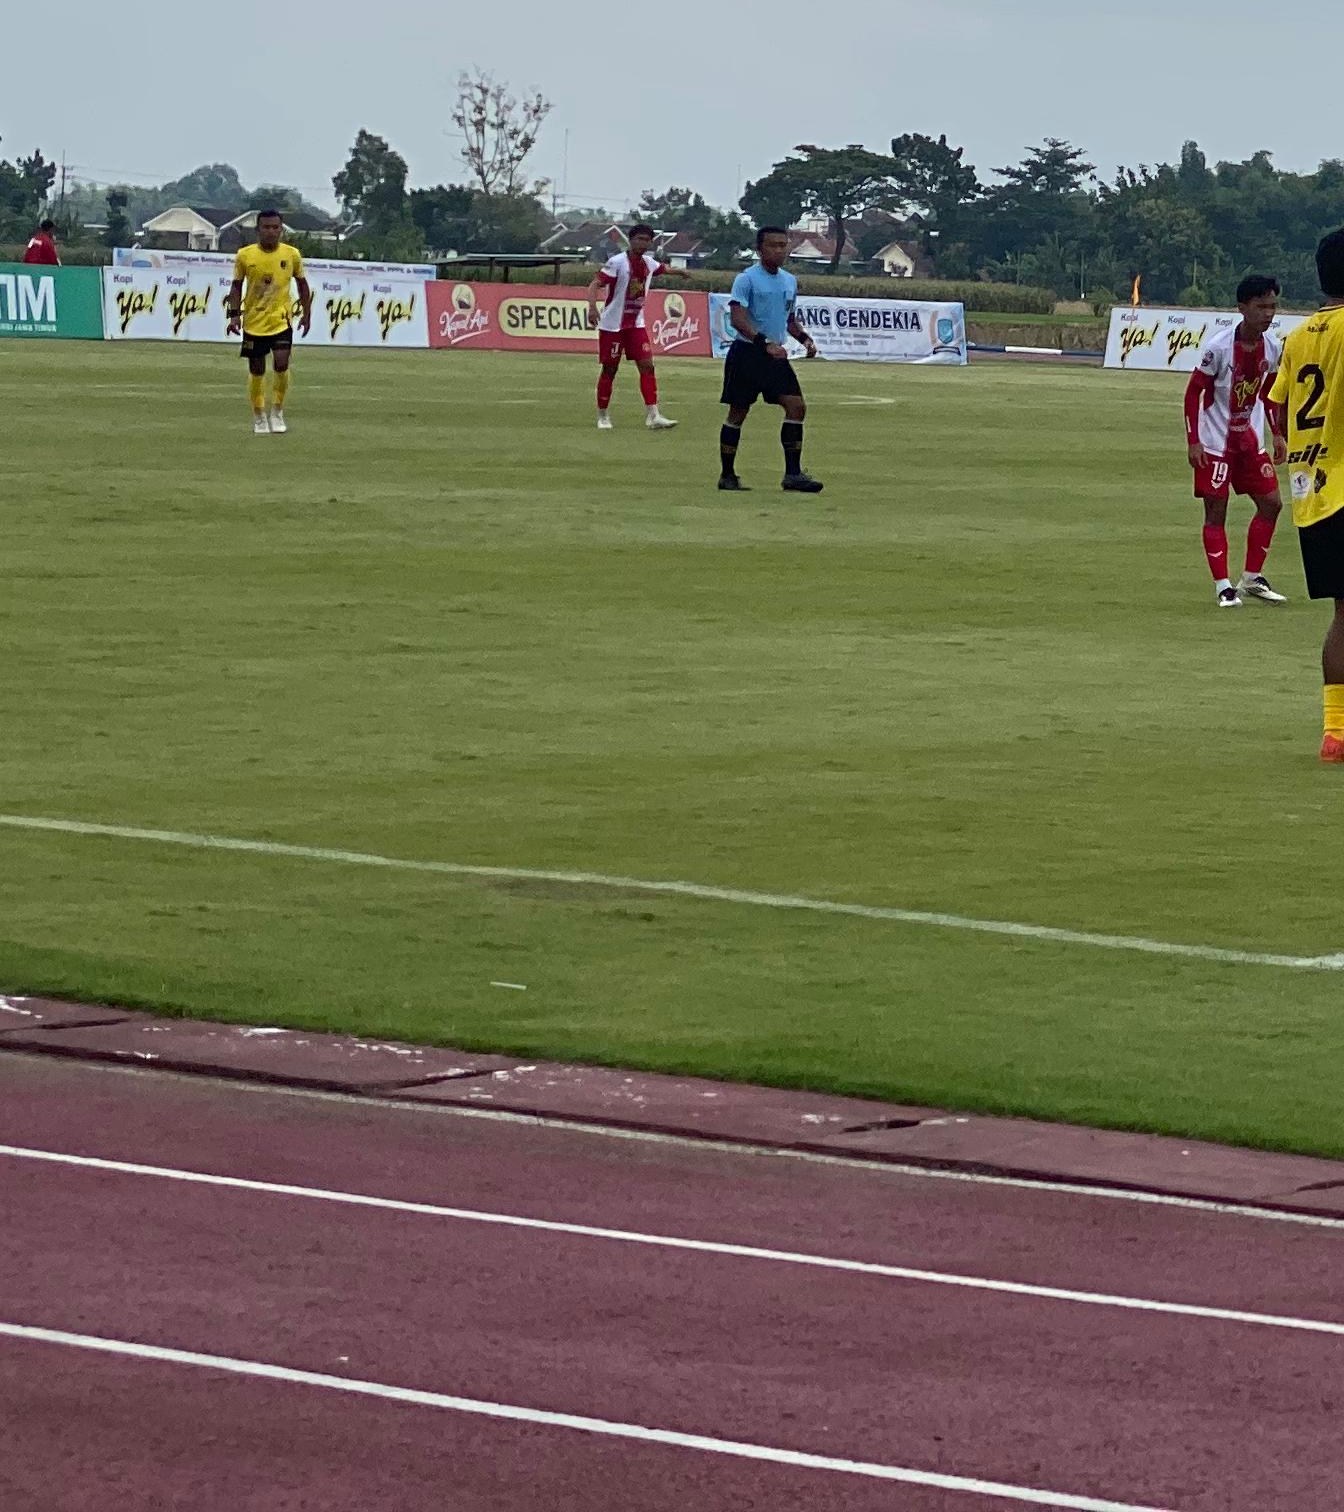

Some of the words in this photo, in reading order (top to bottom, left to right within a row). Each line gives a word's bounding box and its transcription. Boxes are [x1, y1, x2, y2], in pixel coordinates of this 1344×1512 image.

[113, 274, 133, 284] Kopi
[166, 275, 187, 286] Kopi
[322, 282, 342, 292] Kopi
[373, 284, 392, 294] Kopi
[470, 309, 489, 331] Api
[506, 304, 597, 330] SPECIAL
[681, 317, 699, 338] Api
[836, 308, 921, 331] CENDEKIA
[1168, 315, 1186, 324] Kopi
[1296, 364, 1326, 430] 2
[1212, 461, 1229, 482] 19
